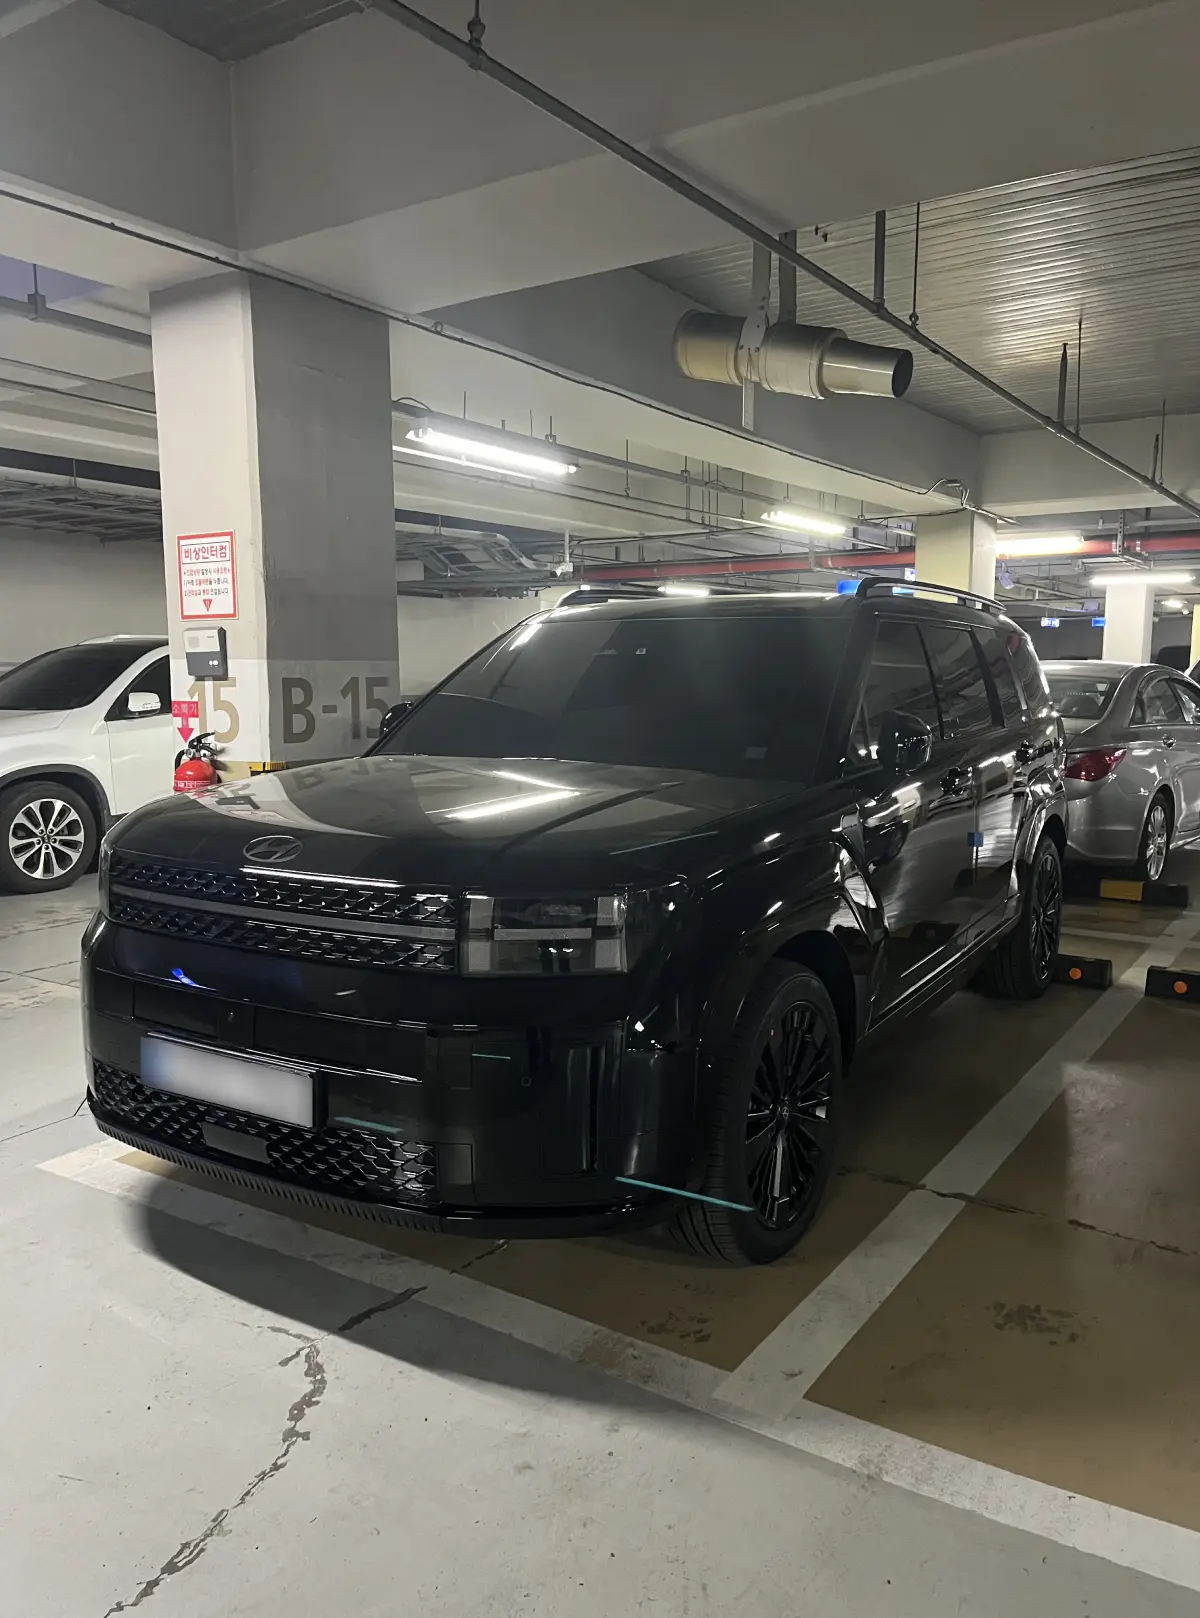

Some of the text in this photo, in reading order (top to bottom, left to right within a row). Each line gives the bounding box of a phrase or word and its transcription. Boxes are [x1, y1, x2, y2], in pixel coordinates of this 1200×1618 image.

[184, 545, 227, 560] 비상인터컴
[187, 677, 240, 744] 15
[281, 677, 389, 744] B-15
